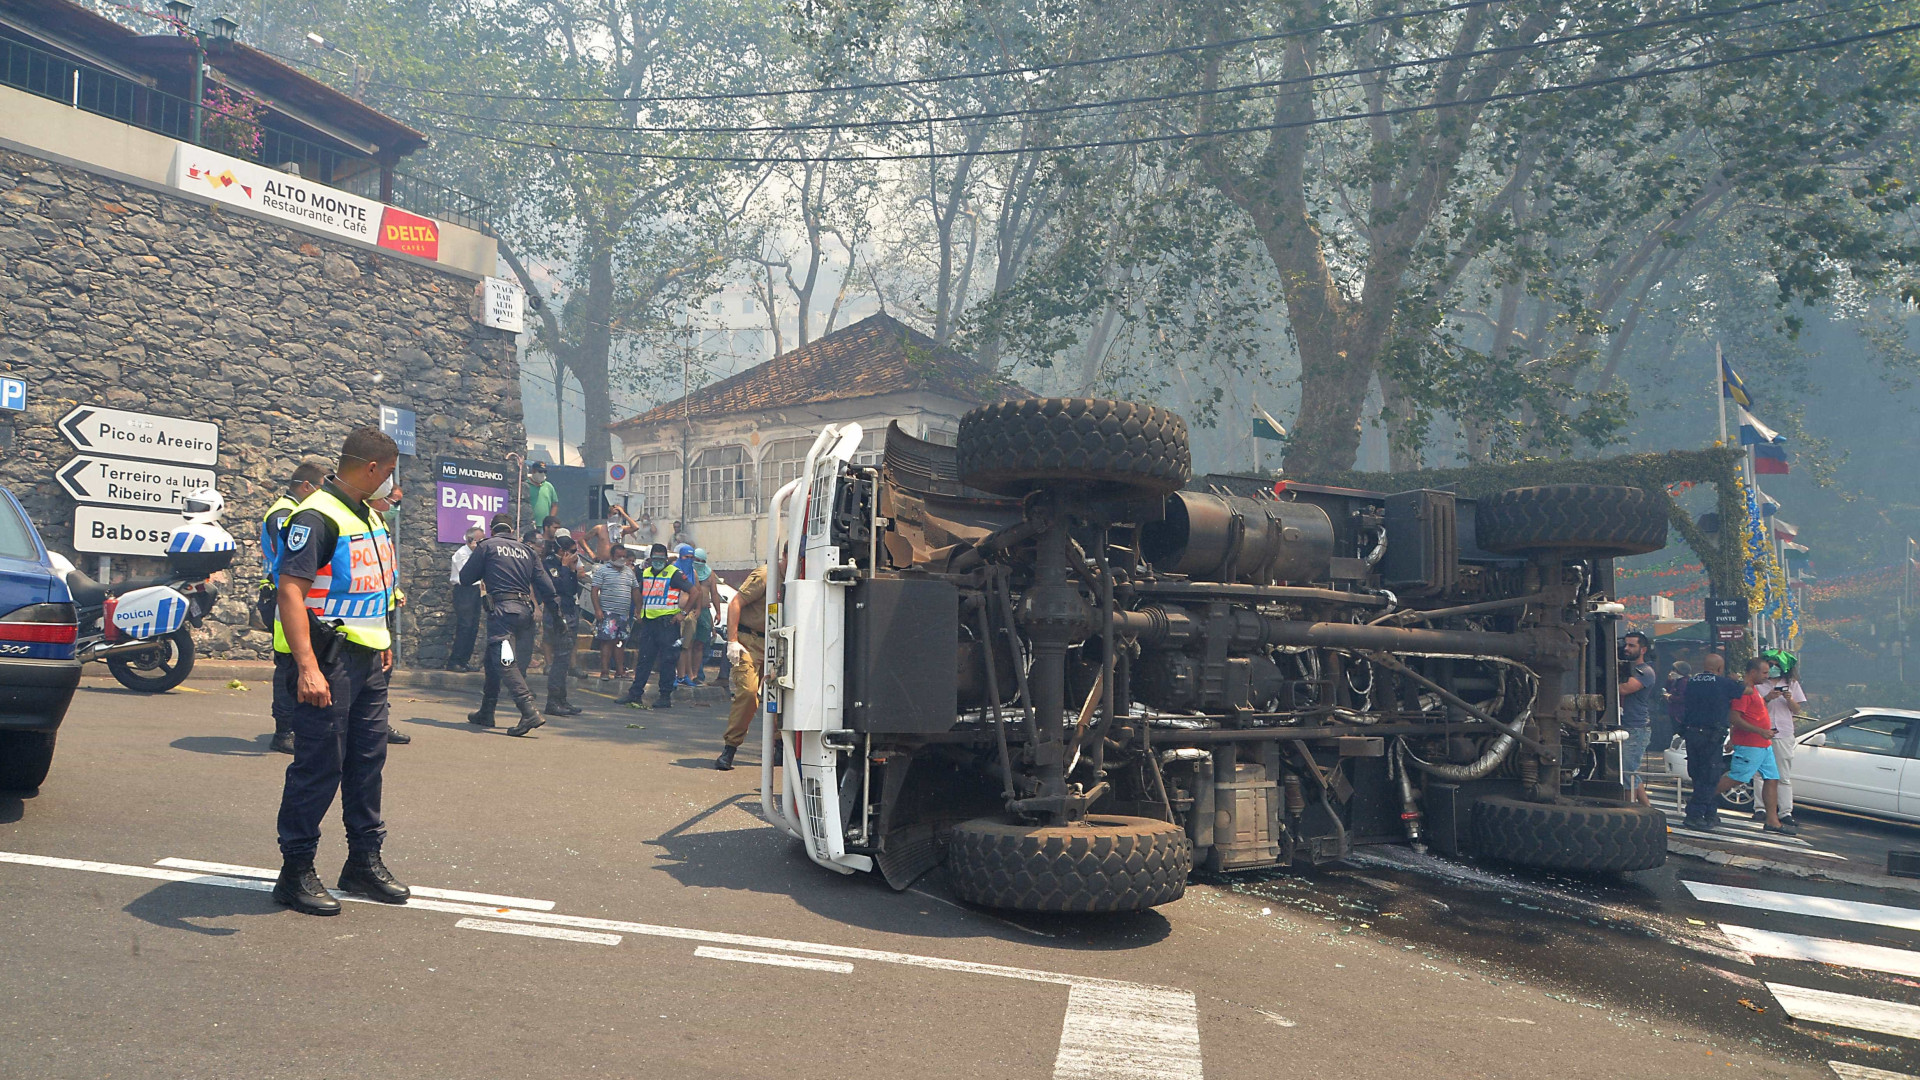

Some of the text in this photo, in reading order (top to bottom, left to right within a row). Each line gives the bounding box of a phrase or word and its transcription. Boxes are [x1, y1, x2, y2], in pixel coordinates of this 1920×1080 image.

[264, 180, 366, 221] ALTO MONTE
[263, 196, 367, 235] Restaurante Café
[386, 224, 436, 242] DELTA
[492, 284, 514, 294] SNACK
[496, 292, 511, 301] BAR
[492, 307, 515, 318] MONTE
[496, 301, 513, 310] ALTO
[2, 379, 22, 407] P
[381, 407, 398, 431] P
[99, 422, 213, 451] Pico do Areeiro
[99, 463, 161, 484] Terreiro
[165, 476, 178, 486] da
[442, 465, 503, 481] MB MULTIBANCO
[108, 483, 162, 502] Ribeiro
[442, 486, 504, 513] BANIF
[91, 520, 171, 543] Babosa
[116, 609, 154, 621] POLÍCIA
